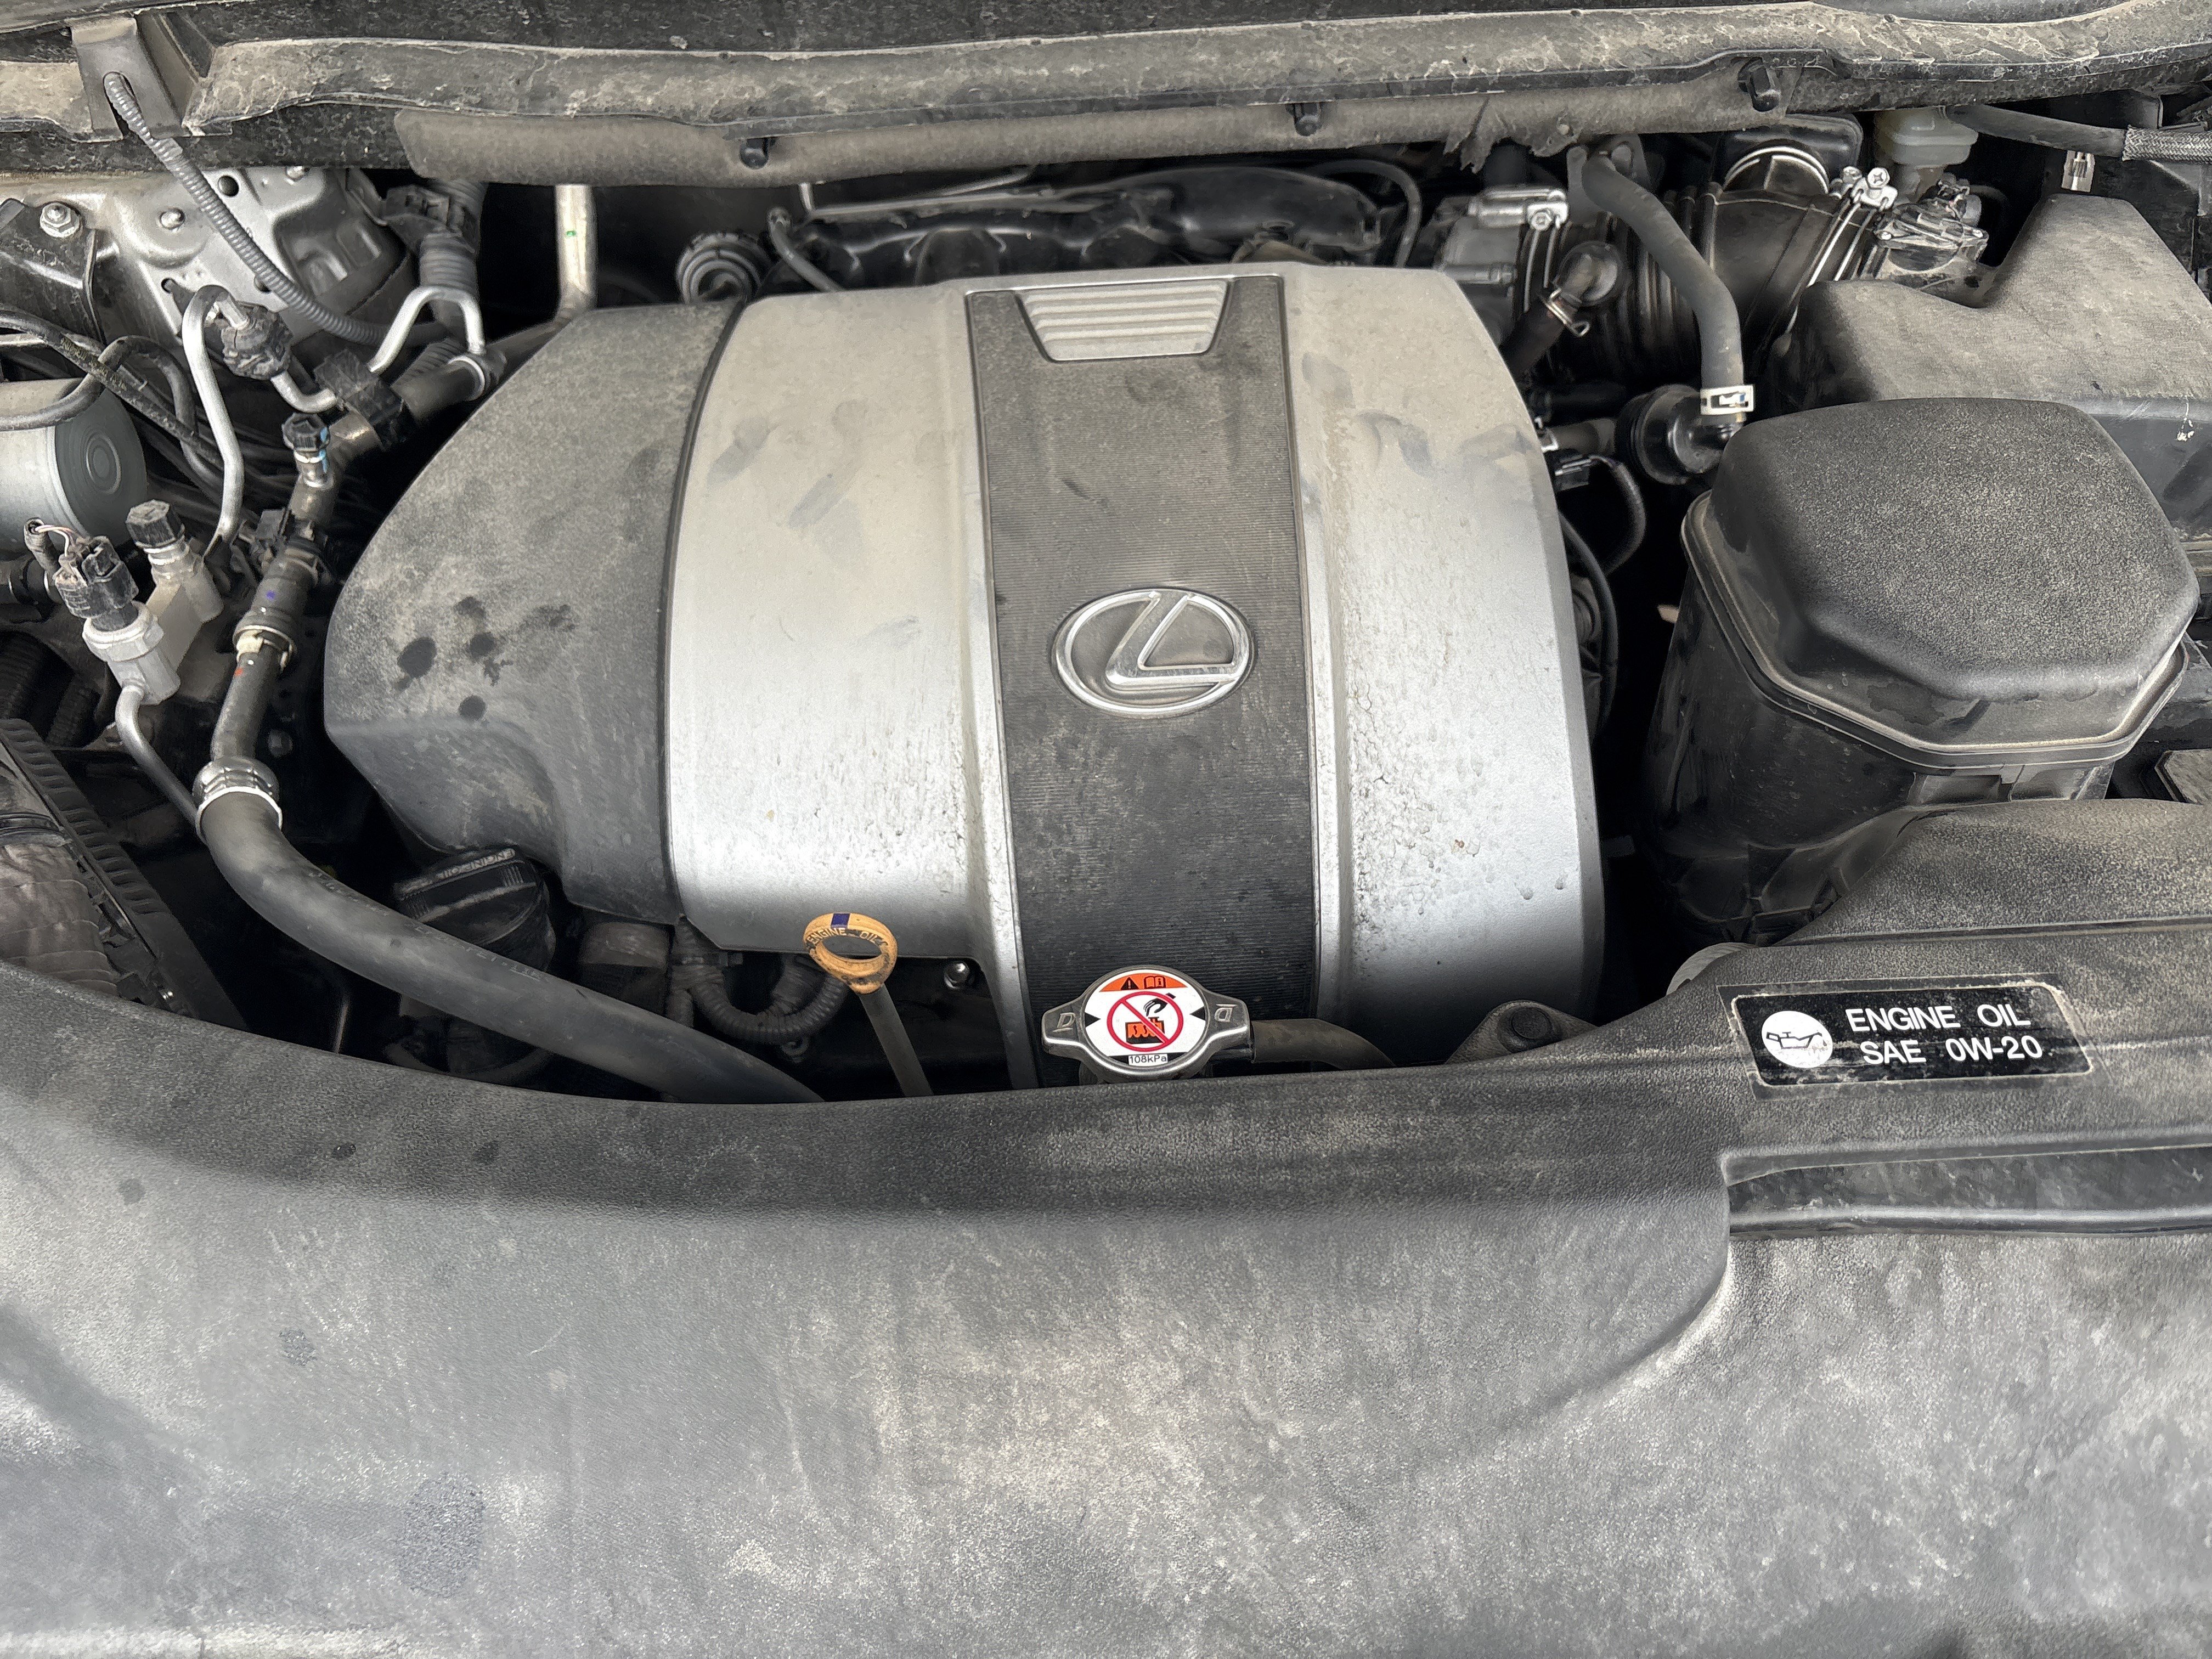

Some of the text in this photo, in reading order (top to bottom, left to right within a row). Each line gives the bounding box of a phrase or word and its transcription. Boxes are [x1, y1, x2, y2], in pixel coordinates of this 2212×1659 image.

[806, 927, 878, 944] ENGINE OIL
[1846, 1004, 2032, 1032] ENGINE OIL
[1129, 1054, 1167, 1064] 108kPa
[1860, 1036, 2043, 1065] SAE 0W-20
